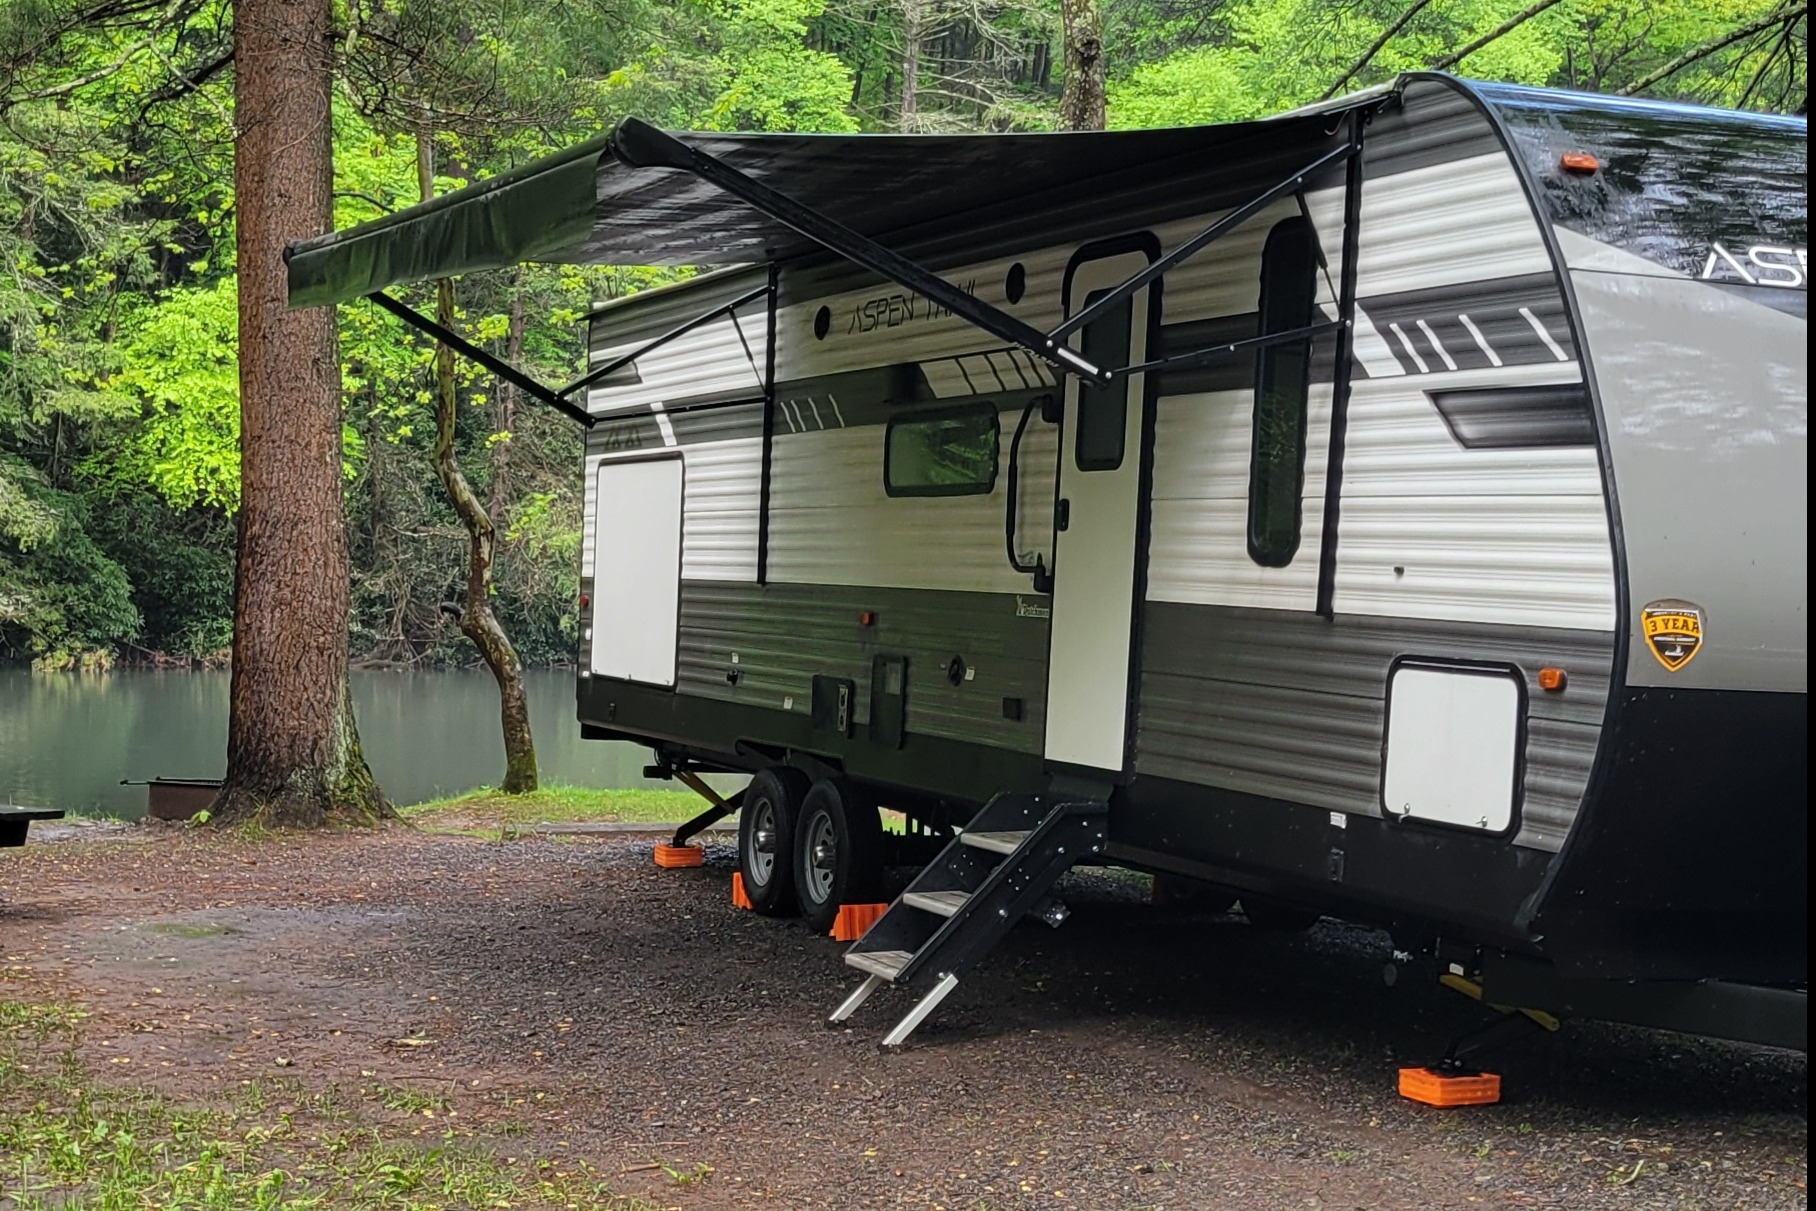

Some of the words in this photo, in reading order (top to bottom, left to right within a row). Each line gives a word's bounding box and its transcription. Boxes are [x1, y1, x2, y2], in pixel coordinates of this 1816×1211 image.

[1701, 241, 1807, 288] AS
[847, 291, 916, 335] ASPEN
[1649, 619, 1658, 633] 3
